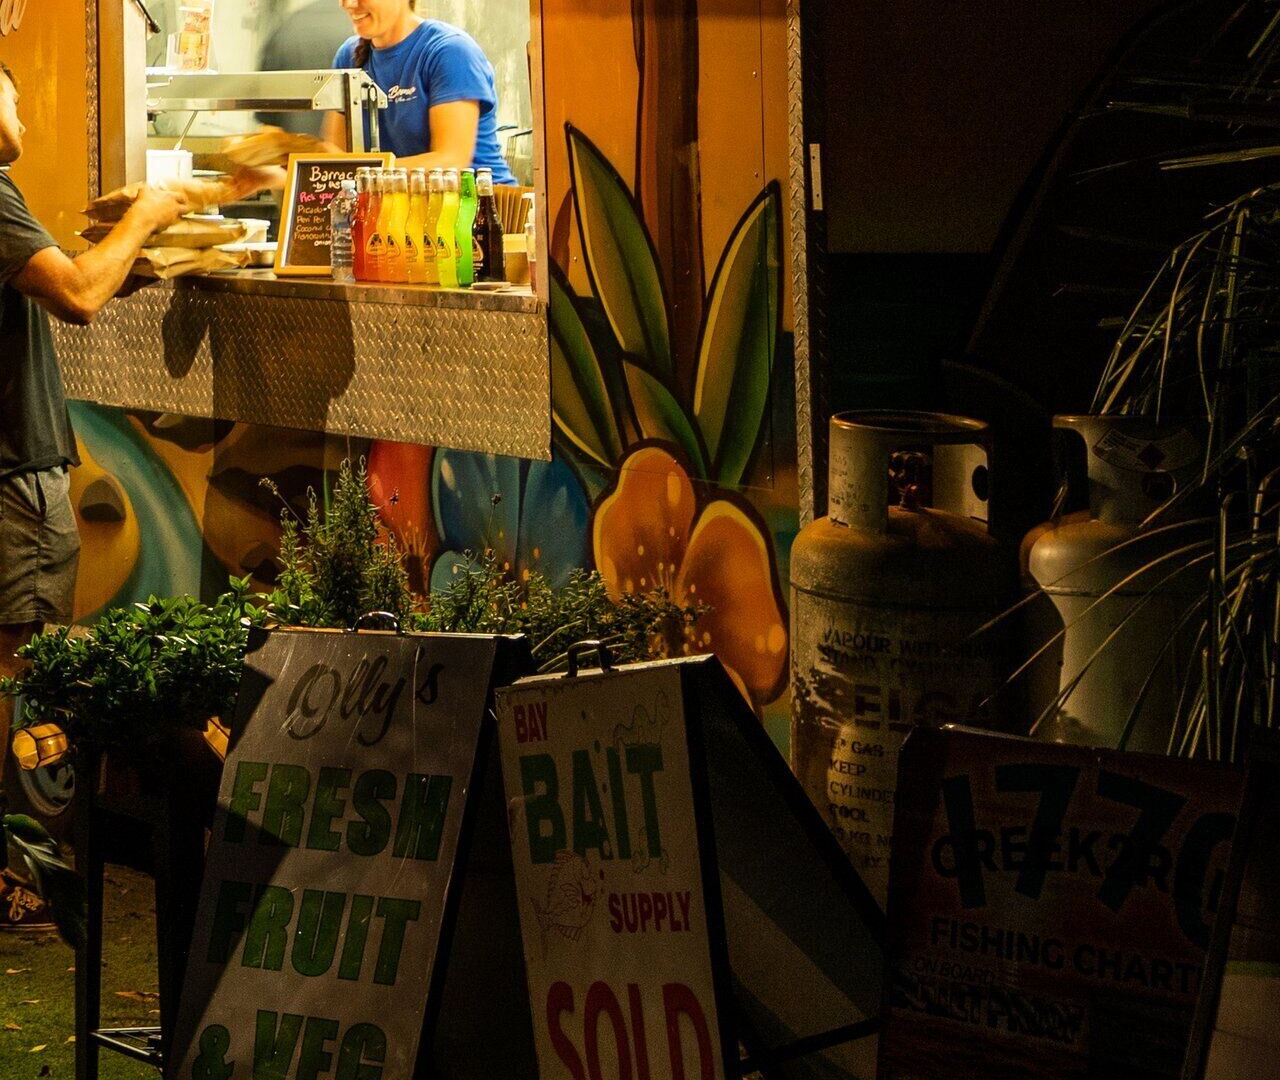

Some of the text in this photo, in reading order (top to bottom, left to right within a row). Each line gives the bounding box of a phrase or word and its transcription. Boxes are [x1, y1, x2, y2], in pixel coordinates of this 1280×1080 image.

[285, 645, 444, 747] Olly's
[513, 701, 548, 743] BAY
[223, 761, 453, 861] FRESH
[519, 743, 664, 864] BAIT
[207, 880, 422, 986] FRUIT
[608, 890, 691, 934] SUPPLY
[929, 918, 1065, 970] FISHING
[252, 1008, 388, 1080] VEG
